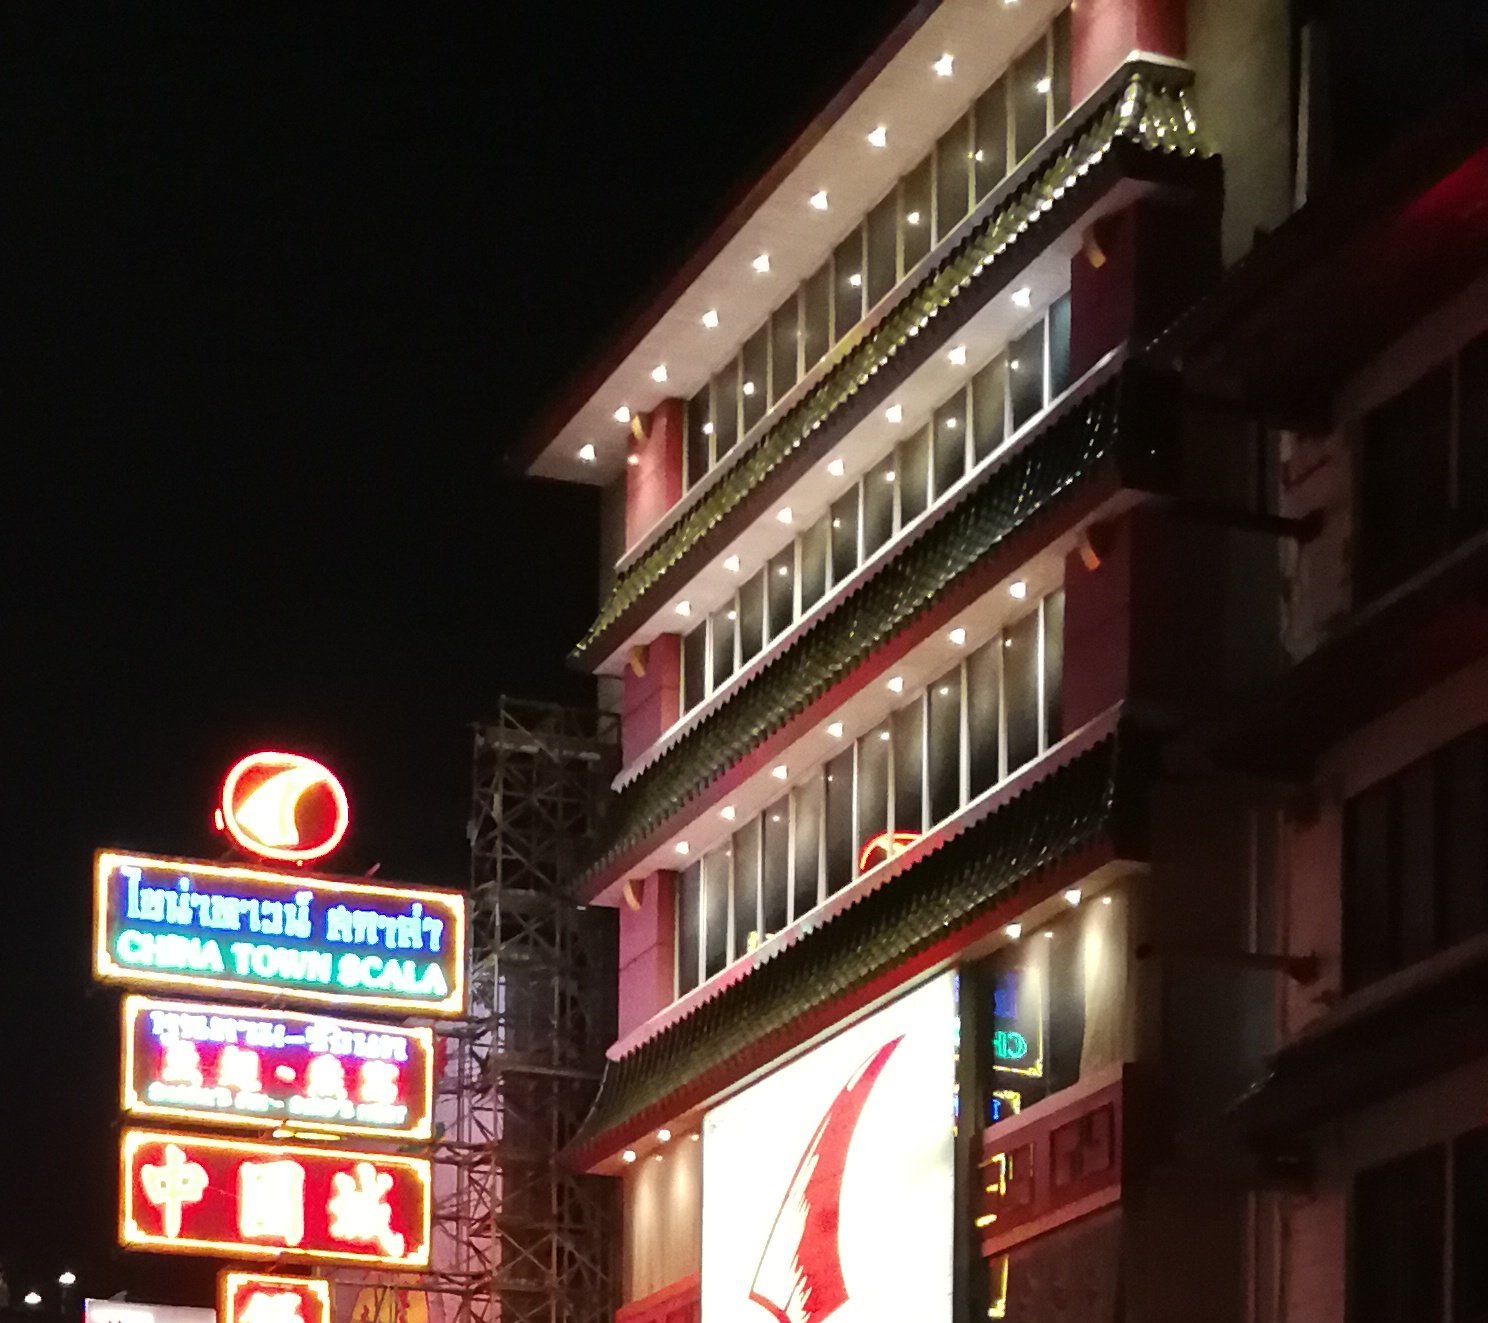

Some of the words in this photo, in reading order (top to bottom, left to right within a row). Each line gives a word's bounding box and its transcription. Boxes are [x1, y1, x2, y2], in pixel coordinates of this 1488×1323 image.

[117, 929, 223, 972] CHINA
[231, 941, 332, 984] TOWN
[337, 953, 448, 998] SCALA
